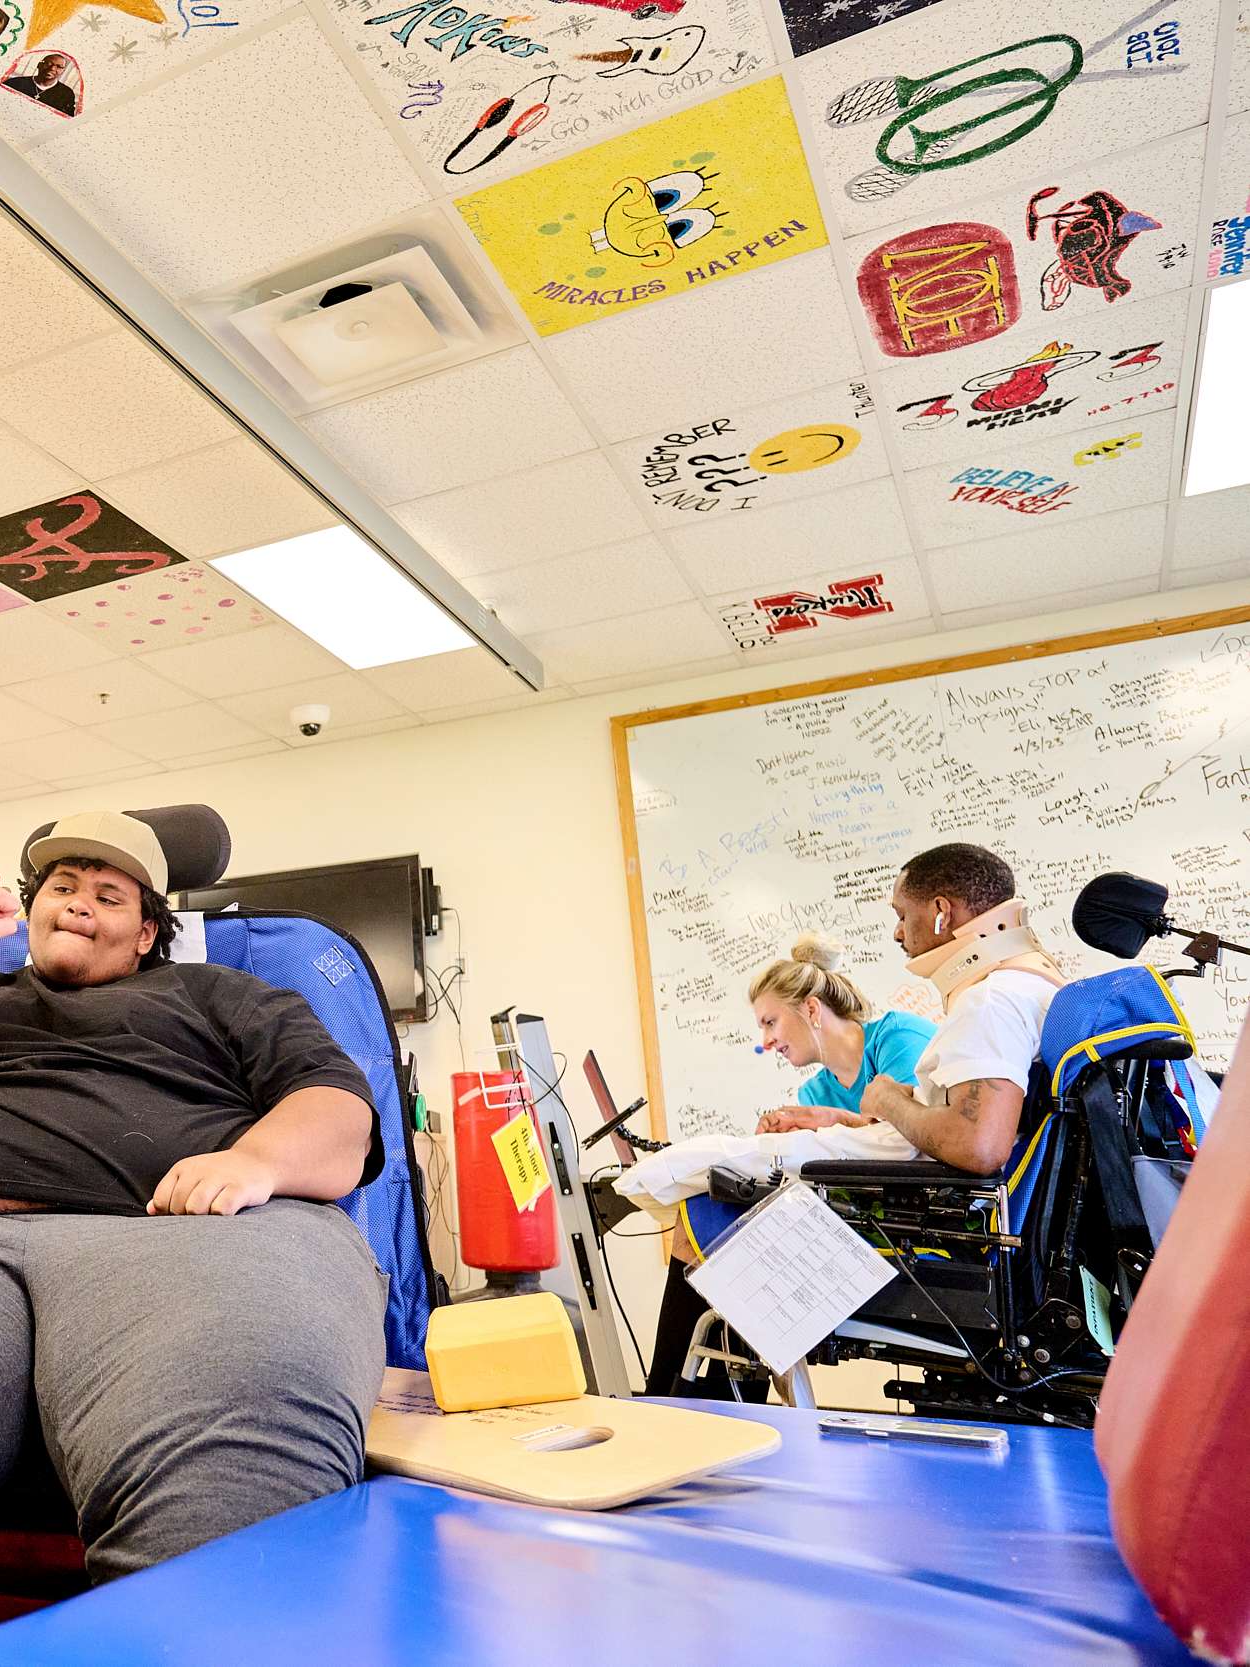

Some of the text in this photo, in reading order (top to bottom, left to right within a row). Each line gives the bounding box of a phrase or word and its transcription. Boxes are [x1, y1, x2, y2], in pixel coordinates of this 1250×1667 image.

[534, 219, 809, 305] MIRACLES HAPPEN
[640, 418, 737, 489] REMEMBER
[950, 467, 1053, 496] BELIEVE
[946, 686, 1025, 715] Always
[1028, 670, 1081, 693] STOP
[1094, 719, 1150, 741] Always
[510, 1137, 529, 1183] Therapy
